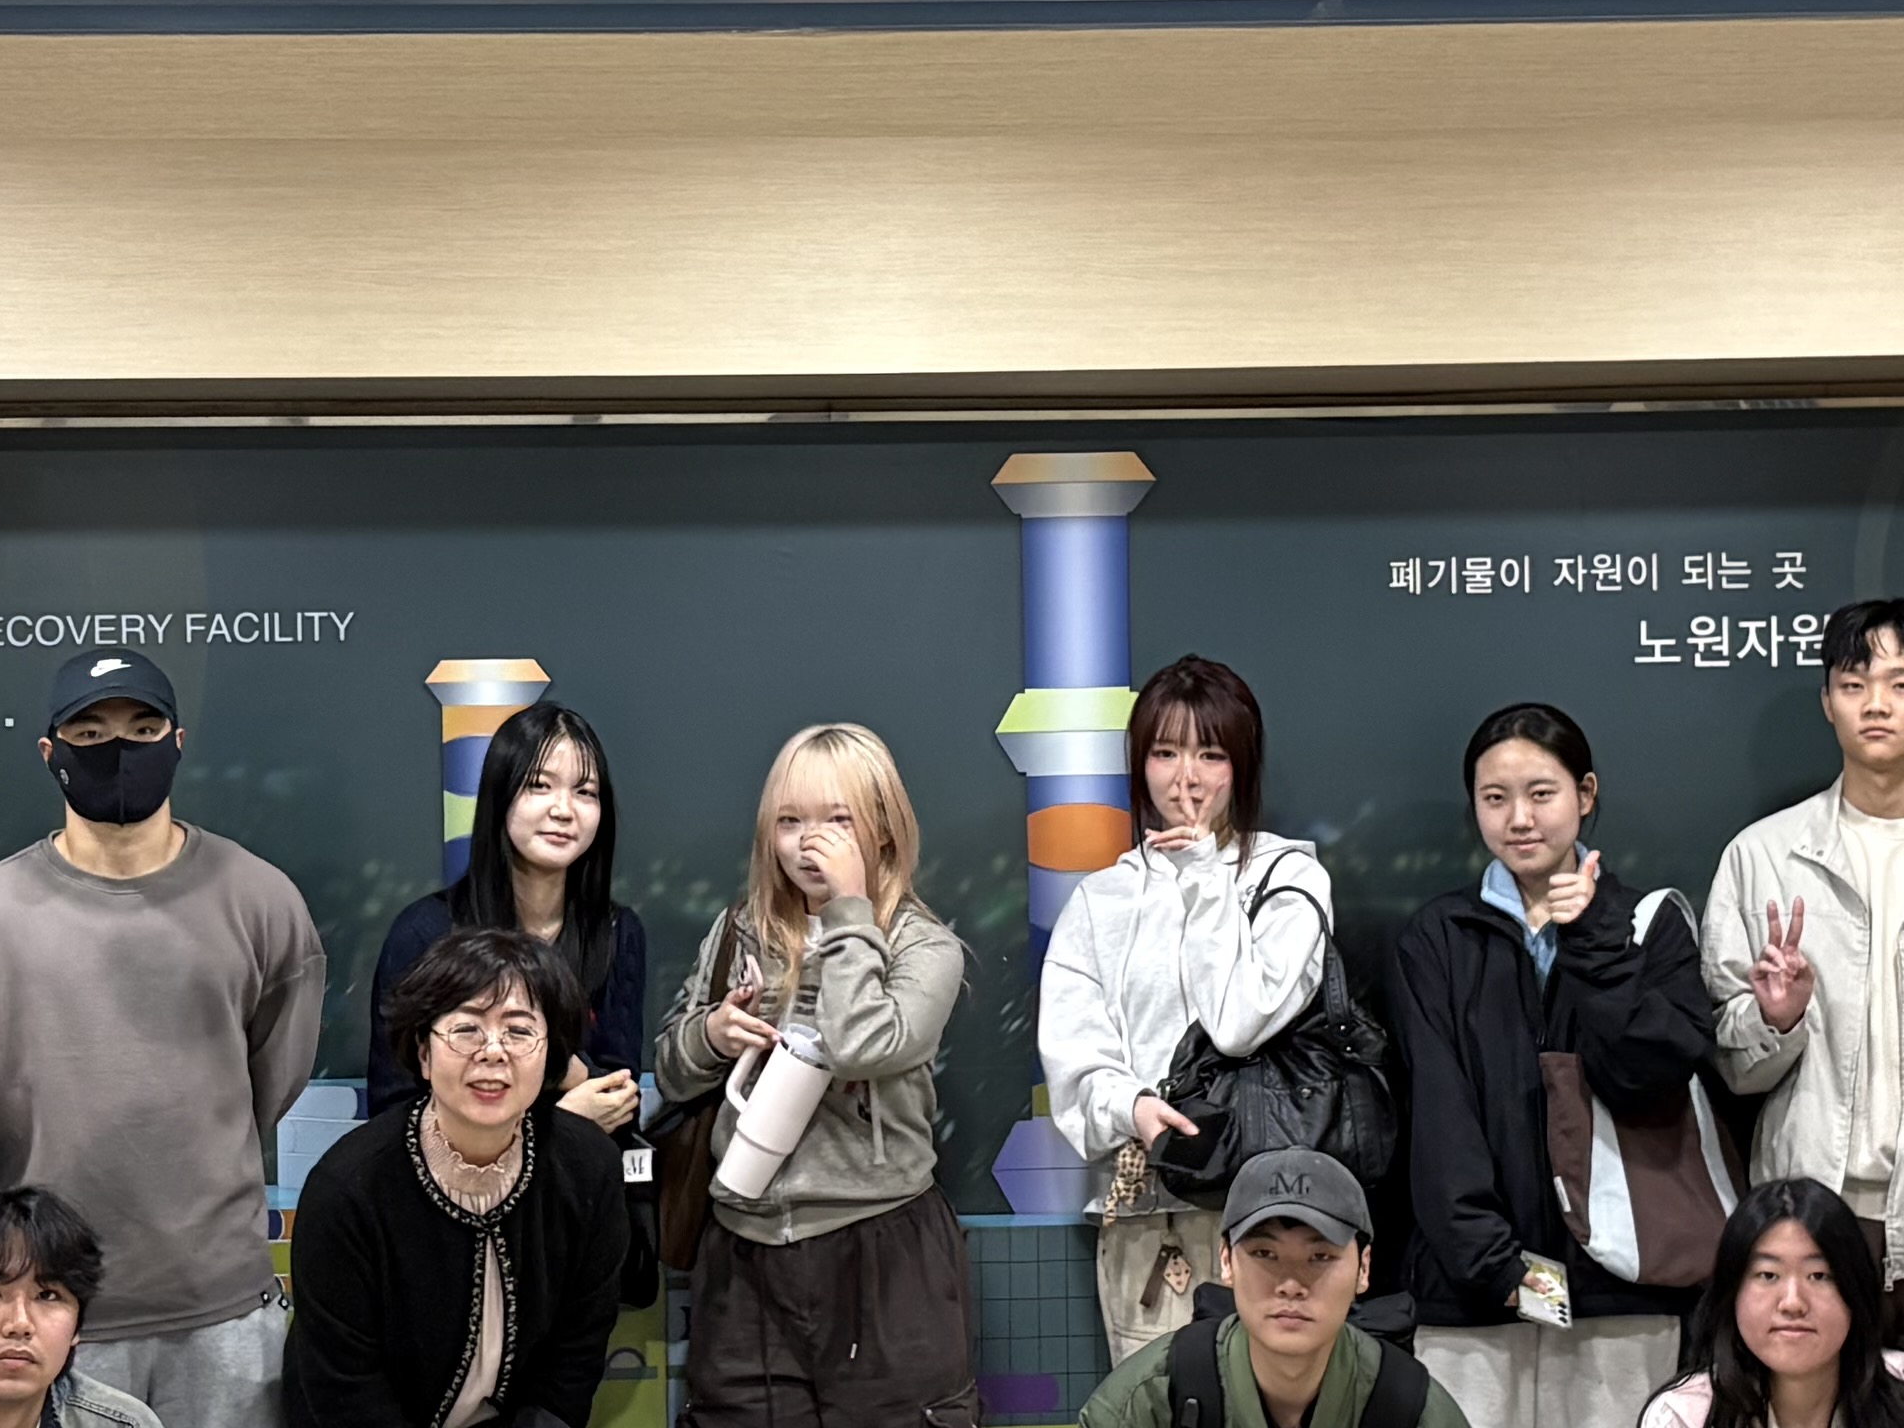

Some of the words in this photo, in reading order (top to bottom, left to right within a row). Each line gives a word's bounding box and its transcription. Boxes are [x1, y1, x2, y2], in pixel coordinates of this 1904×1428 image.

[1389, 555, 1531, 595] 폐기물이
[1553, 552, 1658, 593] 자원이
[1681, 552, 1752, 591] 되는
[1772, 552, 1807, 590] 곳
[185, 610, 355, 643] FACILITY
